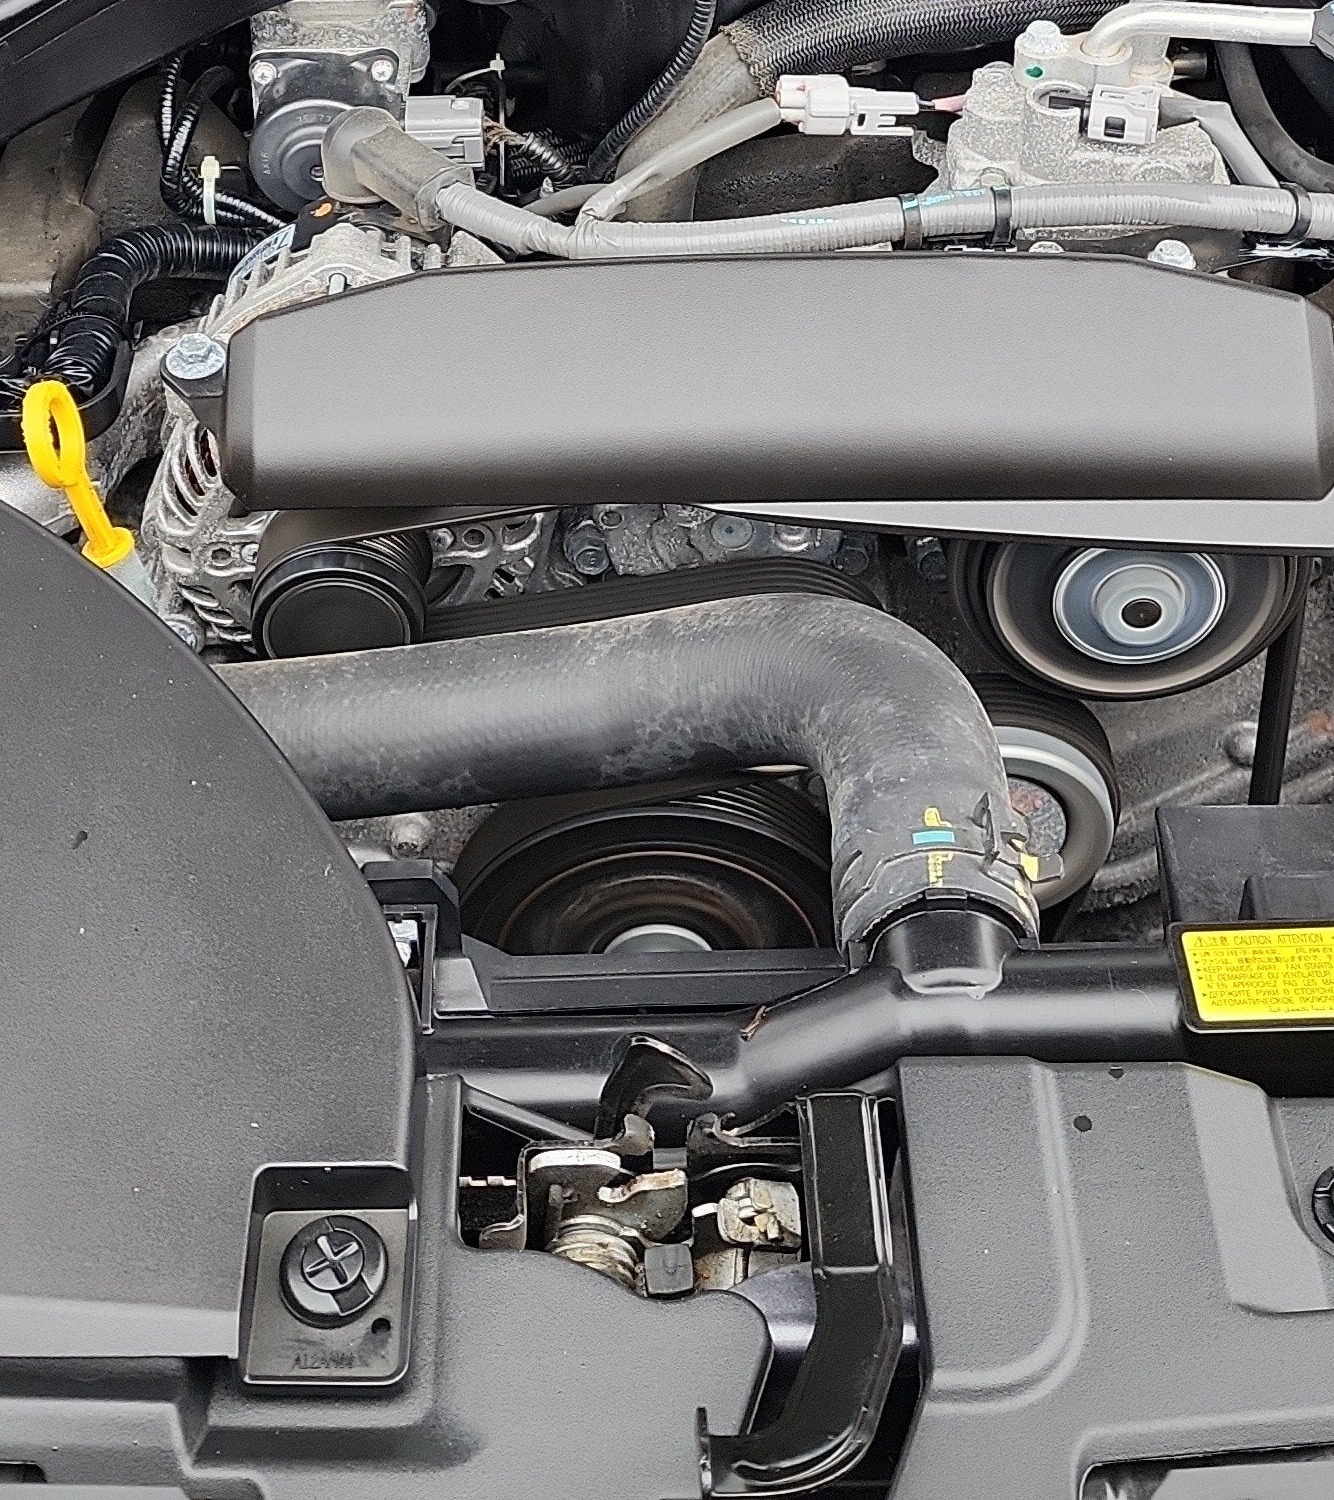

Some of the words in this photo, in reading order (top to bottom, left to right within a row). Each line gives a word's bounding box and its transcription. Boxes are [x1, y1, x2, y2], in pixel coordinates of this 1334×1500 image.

[1233, 935, 1272, 946] CAUTION
[1277, 933, 1324, 944] ATTENTION
[1203, 965, 1223, 974] KEEP
[1286, 963, 1301, 971] FAN
[1304, 961, 1334, 970] STARTS
[1283, 979, 1298, 987] PAS
[1303, 978, 1318, 987] LES
